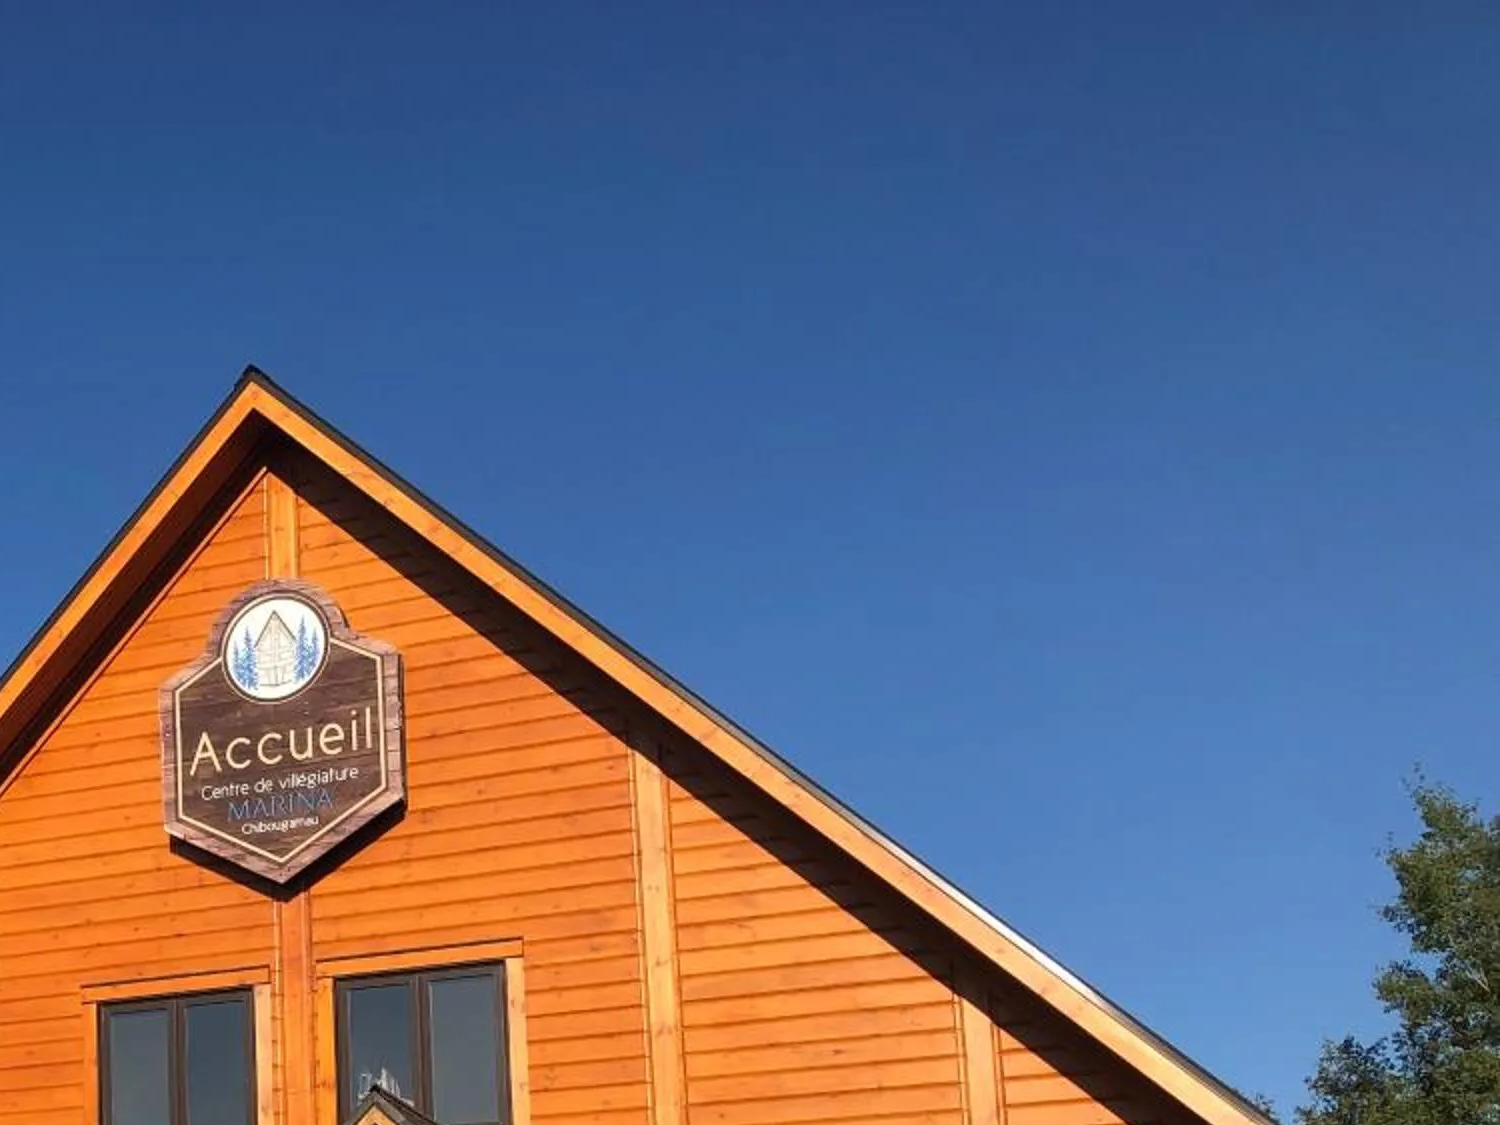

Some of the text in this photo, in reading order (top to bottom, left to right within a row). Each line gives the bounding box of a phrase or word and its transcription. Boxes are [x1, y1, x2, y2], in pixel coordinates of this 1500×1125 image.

[190, 707, 373, 776] Accueil
[201, 782, 249, 800] Centre
[254, 778, 273, 792] de
[227, 788, 333, 822] MARINA
